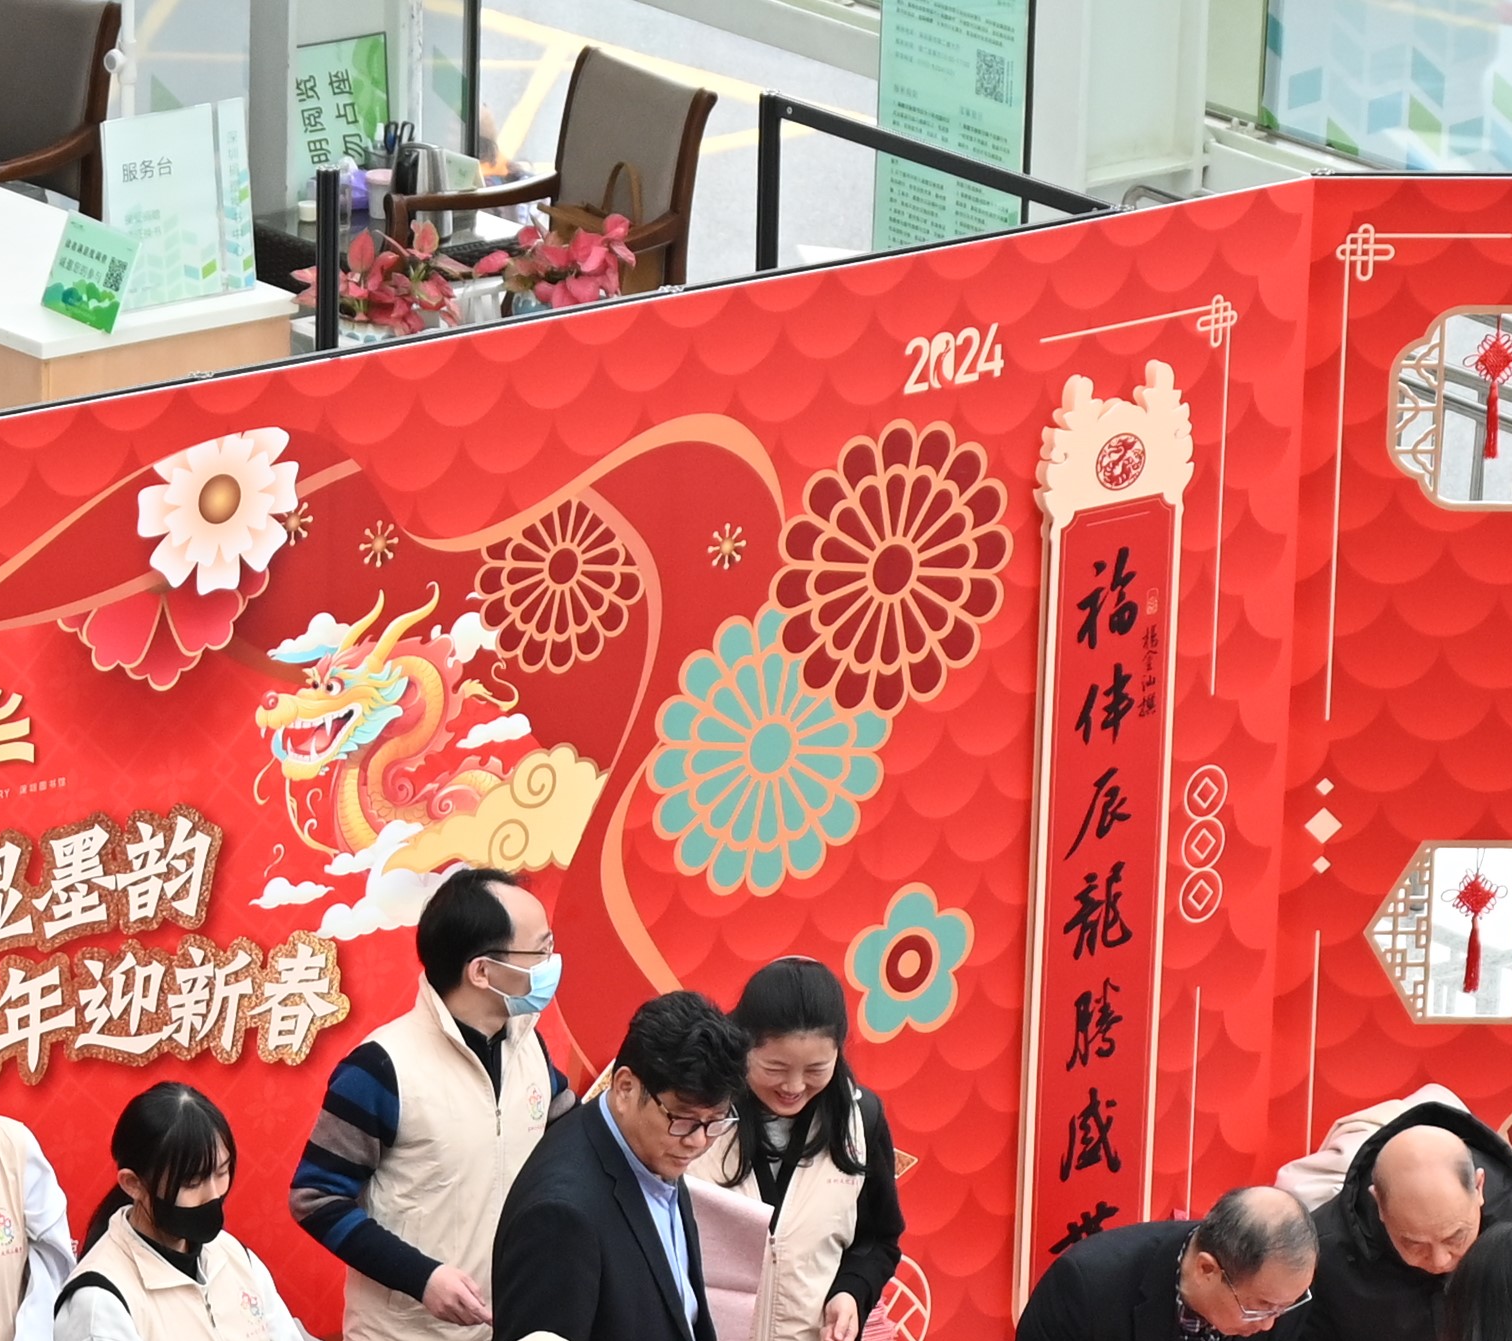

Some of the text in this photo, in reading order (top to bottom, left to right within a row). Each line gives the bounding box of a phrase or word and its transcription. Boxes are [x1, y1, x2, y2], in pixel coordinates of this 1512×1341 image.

[122, 156, 173, 183] 服务台
[904, 323, 1004, 395] 2024
